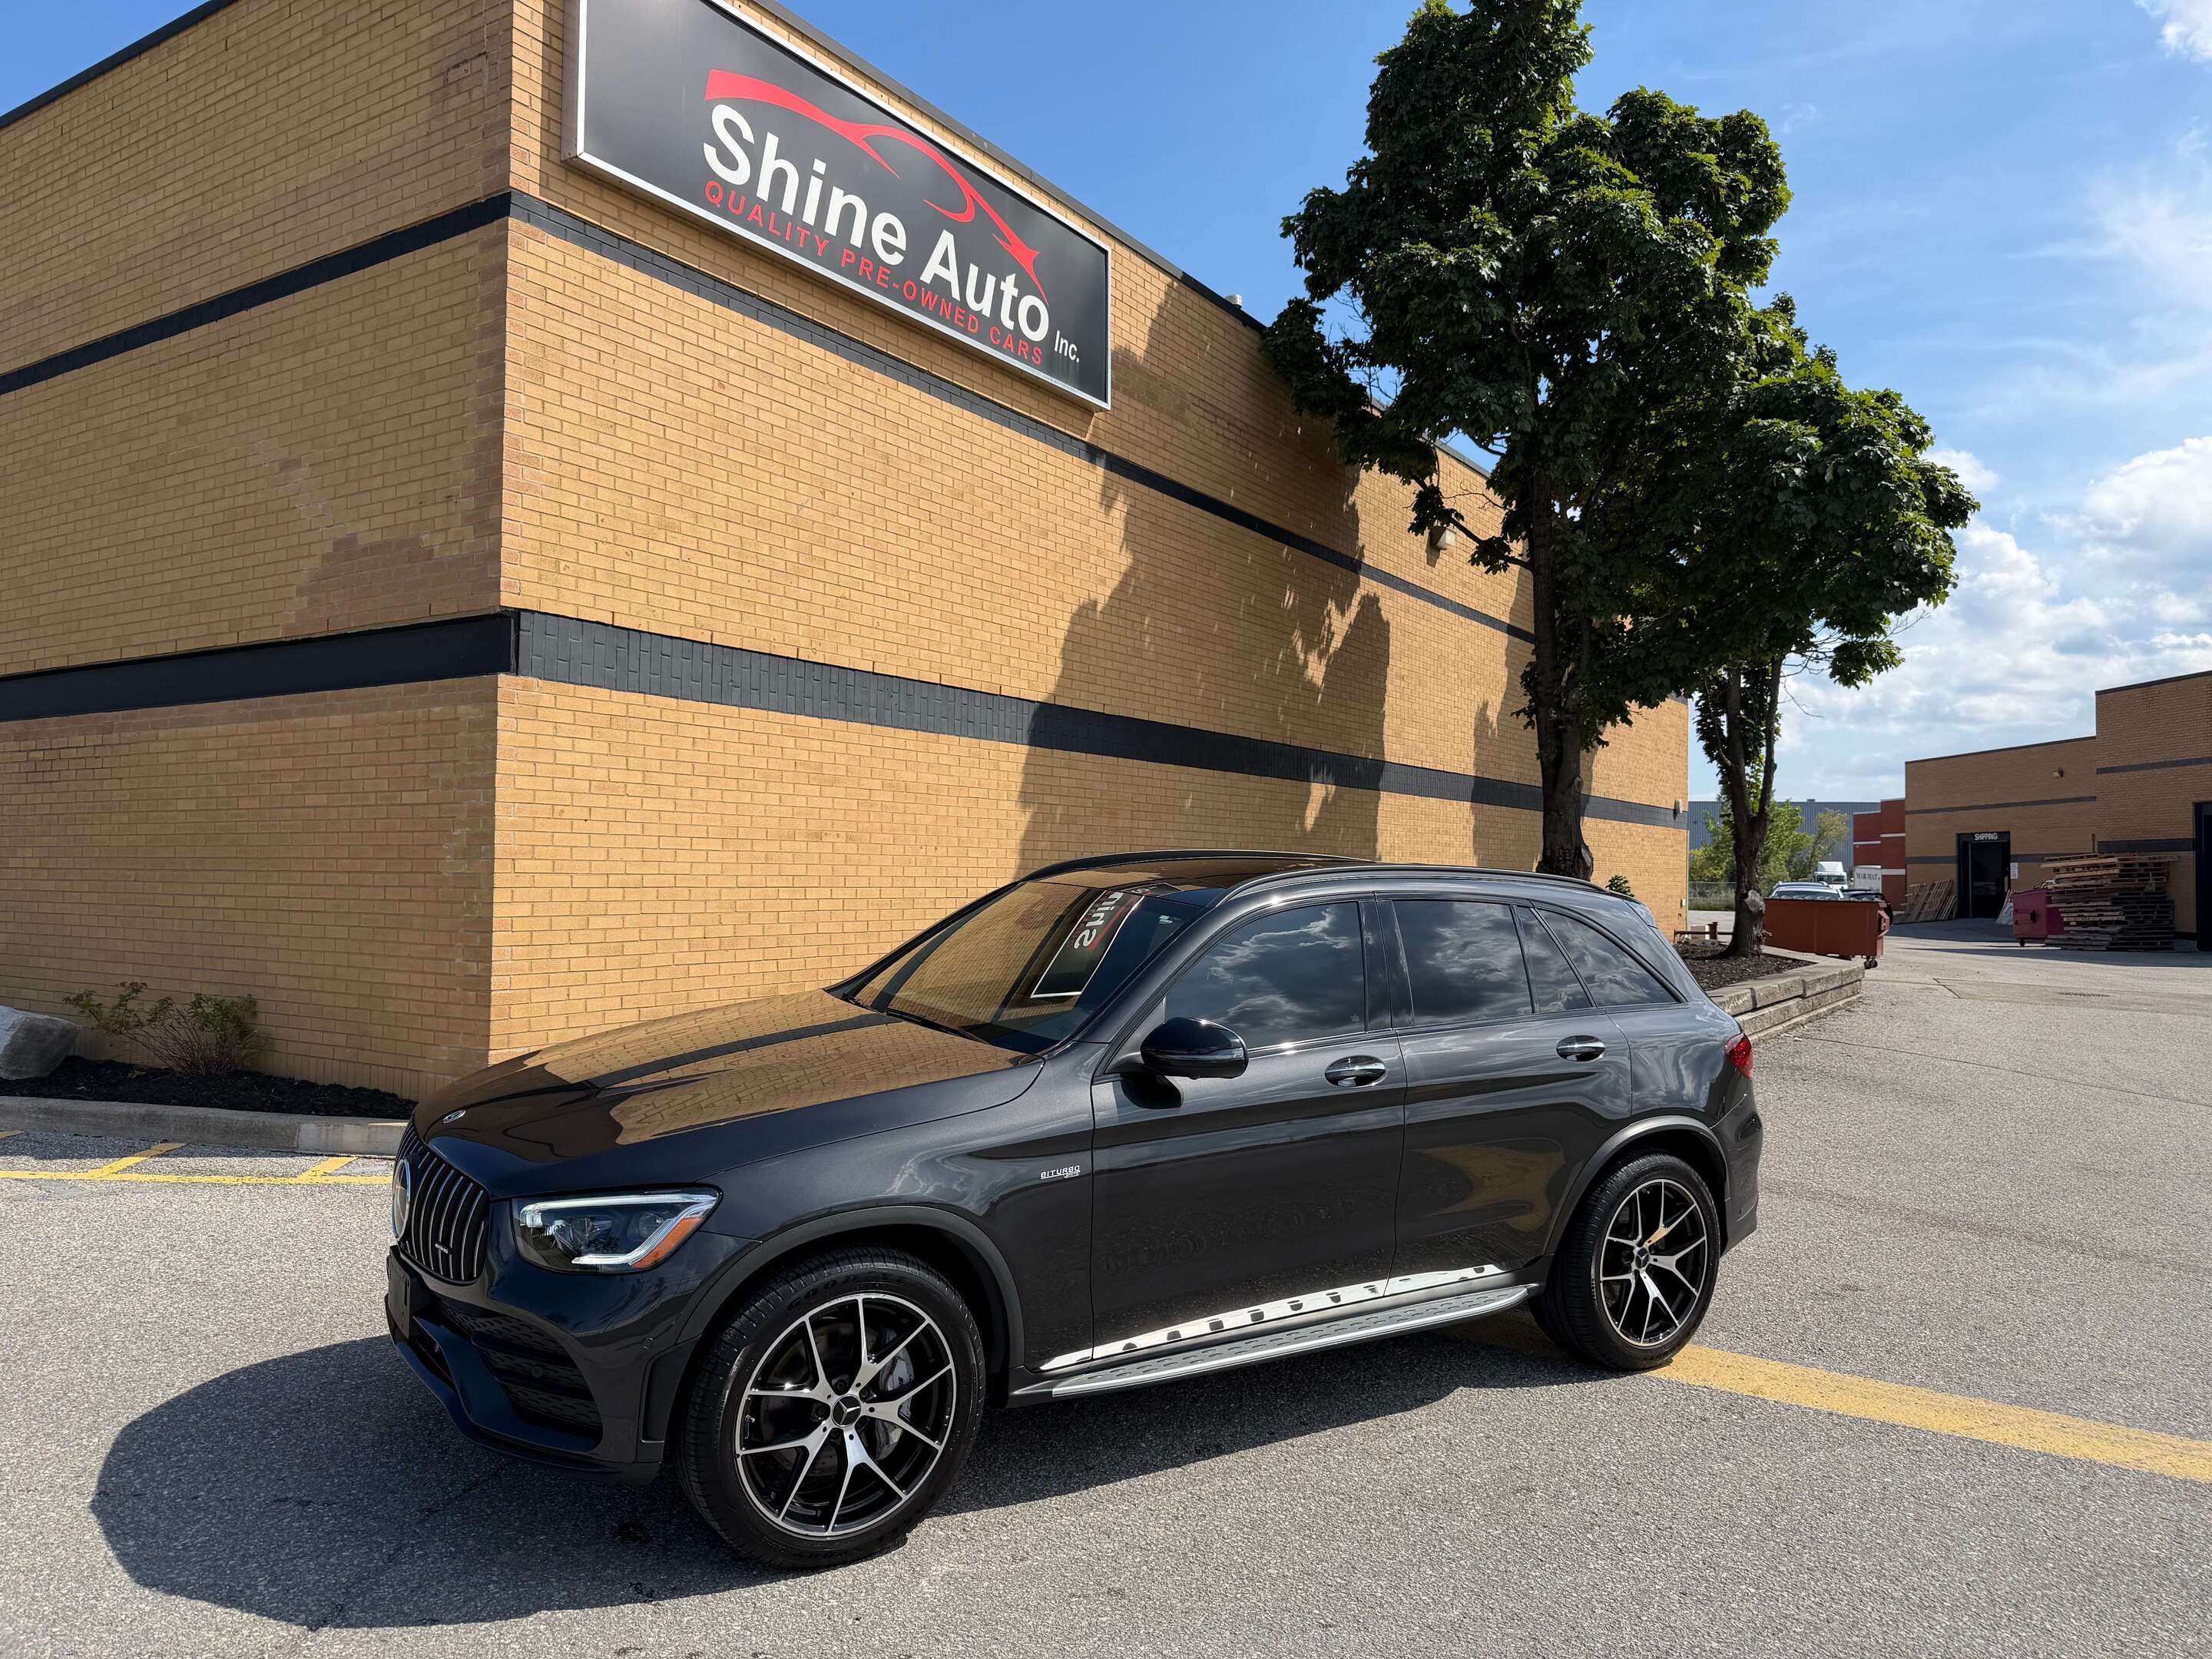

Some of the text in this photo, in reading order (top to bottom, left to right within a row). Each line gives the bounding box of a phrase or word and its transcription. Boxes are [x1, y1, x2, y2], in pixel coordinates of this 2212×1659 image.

[704, 104, 1080, 363] Shine Auto Inc.
[705, 180, 1043, 366] QUALITY PRE-OWNED CARS
[1974, 833, 1998, 841] SHIPPING
[1040, 1165, 1081, 1179] BITURBO
